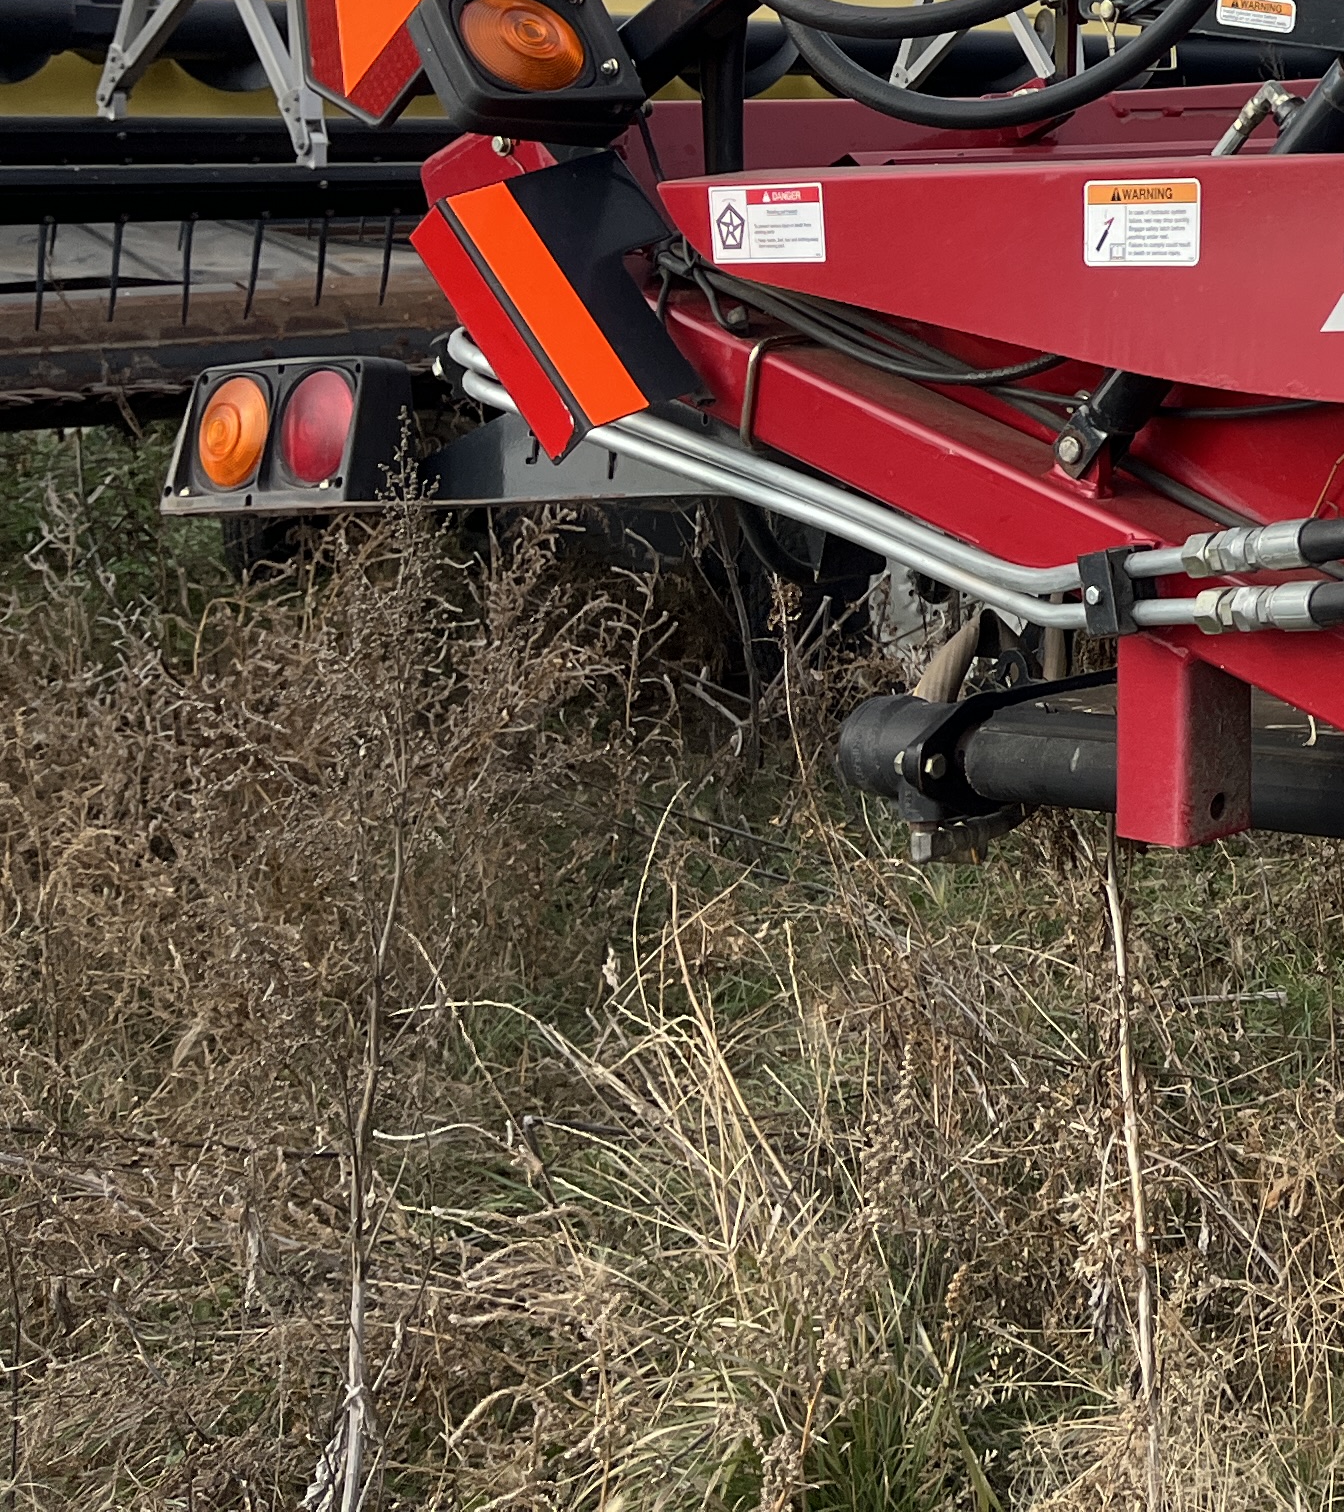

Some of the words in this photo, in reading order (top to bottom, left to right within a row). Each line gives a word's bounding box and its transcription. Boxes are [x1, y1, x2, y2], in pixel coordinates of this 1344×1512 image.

[1241, 0, 1283, 14] WARNING
[771, 190, 802, 201] DANGER
[1122, 187, 1173, 200] WARNING
